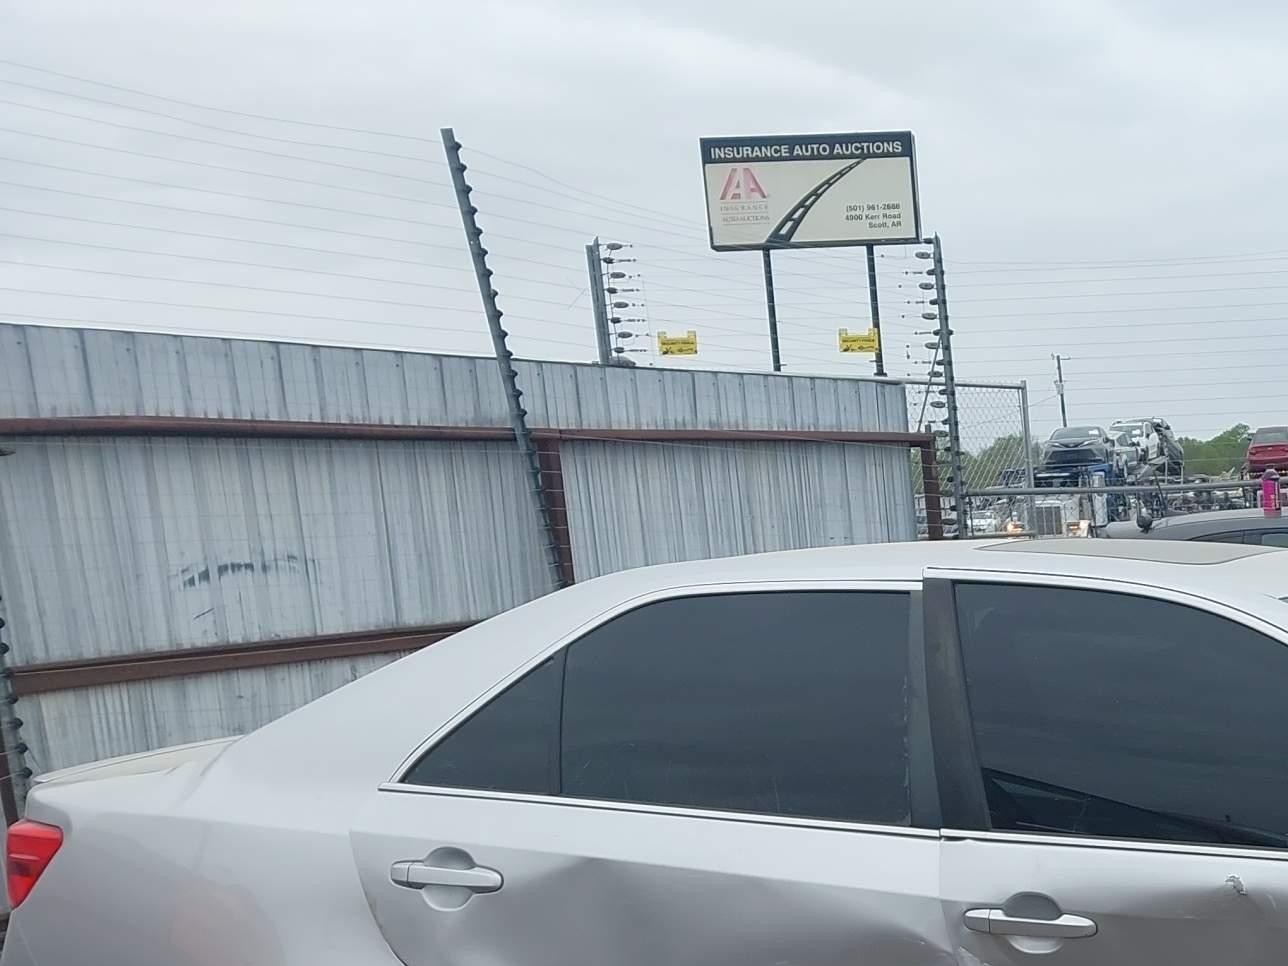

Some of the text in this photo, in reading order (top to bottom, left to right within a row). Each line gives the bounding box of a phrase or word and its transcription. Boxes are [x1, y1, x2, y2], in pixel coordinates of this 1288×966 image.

[710, 141, 902, 159] INSURANCE AUTO AUCTIONS
[846, 204, 865, 213] (501)
[865, 212, 881, 221] Kerr
[882, 212, 902, 220] Road
[891, 220, 902, 229] AR
